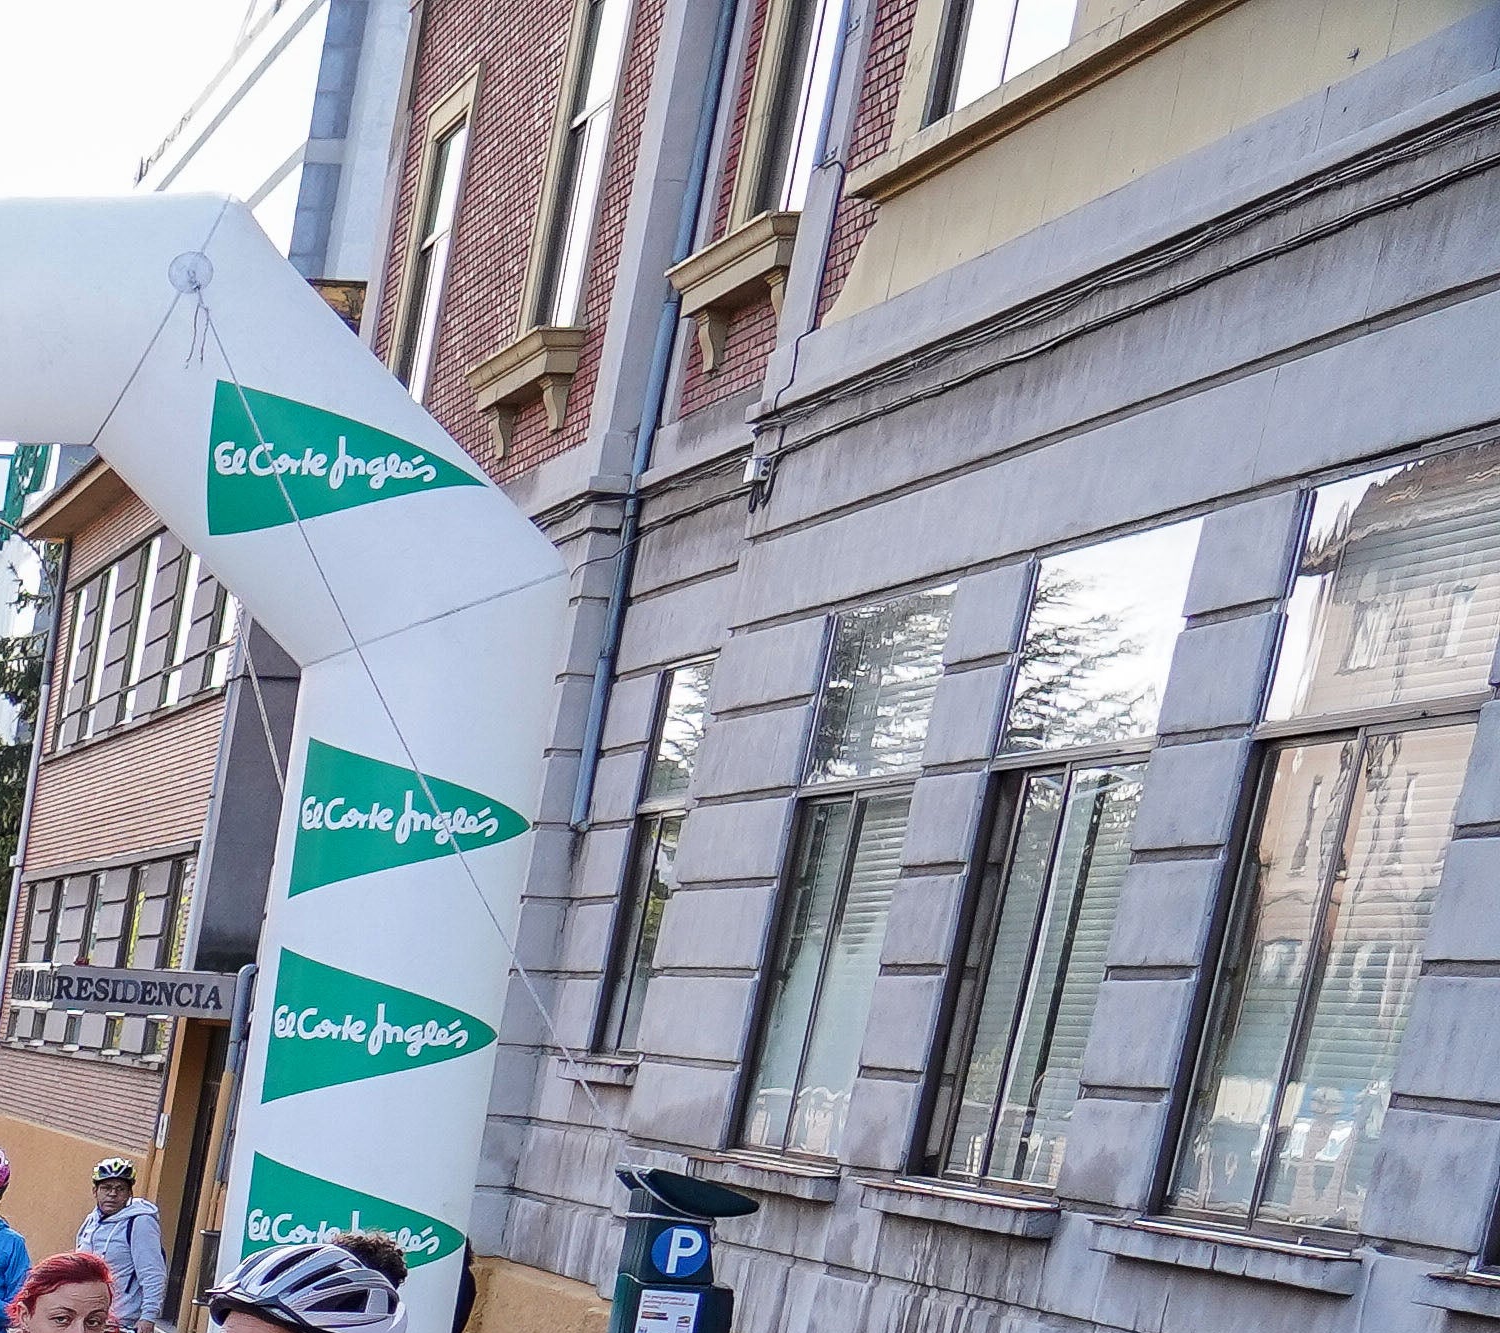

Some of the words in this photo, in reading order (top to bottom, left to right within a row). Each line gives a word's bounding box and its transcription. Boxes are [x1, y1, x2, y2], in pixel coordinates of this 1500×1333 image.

[213, 441, 246, 475] El
[249, 443, 327, 476] Corte
[328, 436, 437, 490] Inglés
[301, 795, 324, 830] El
[324, 798, 393, 832] Corte
[394, 790, 499, 845] Inglés
[54, 975, 223, 1010] RESIDENCIA
[274, 1004, 297, 1039] El
[297, 1007, 367, 1043] Corte
[368, 1003, 469, 1057] Inglés
[248, 1209, 271, 1241] El
[666, 1228, 703, 1274] P
